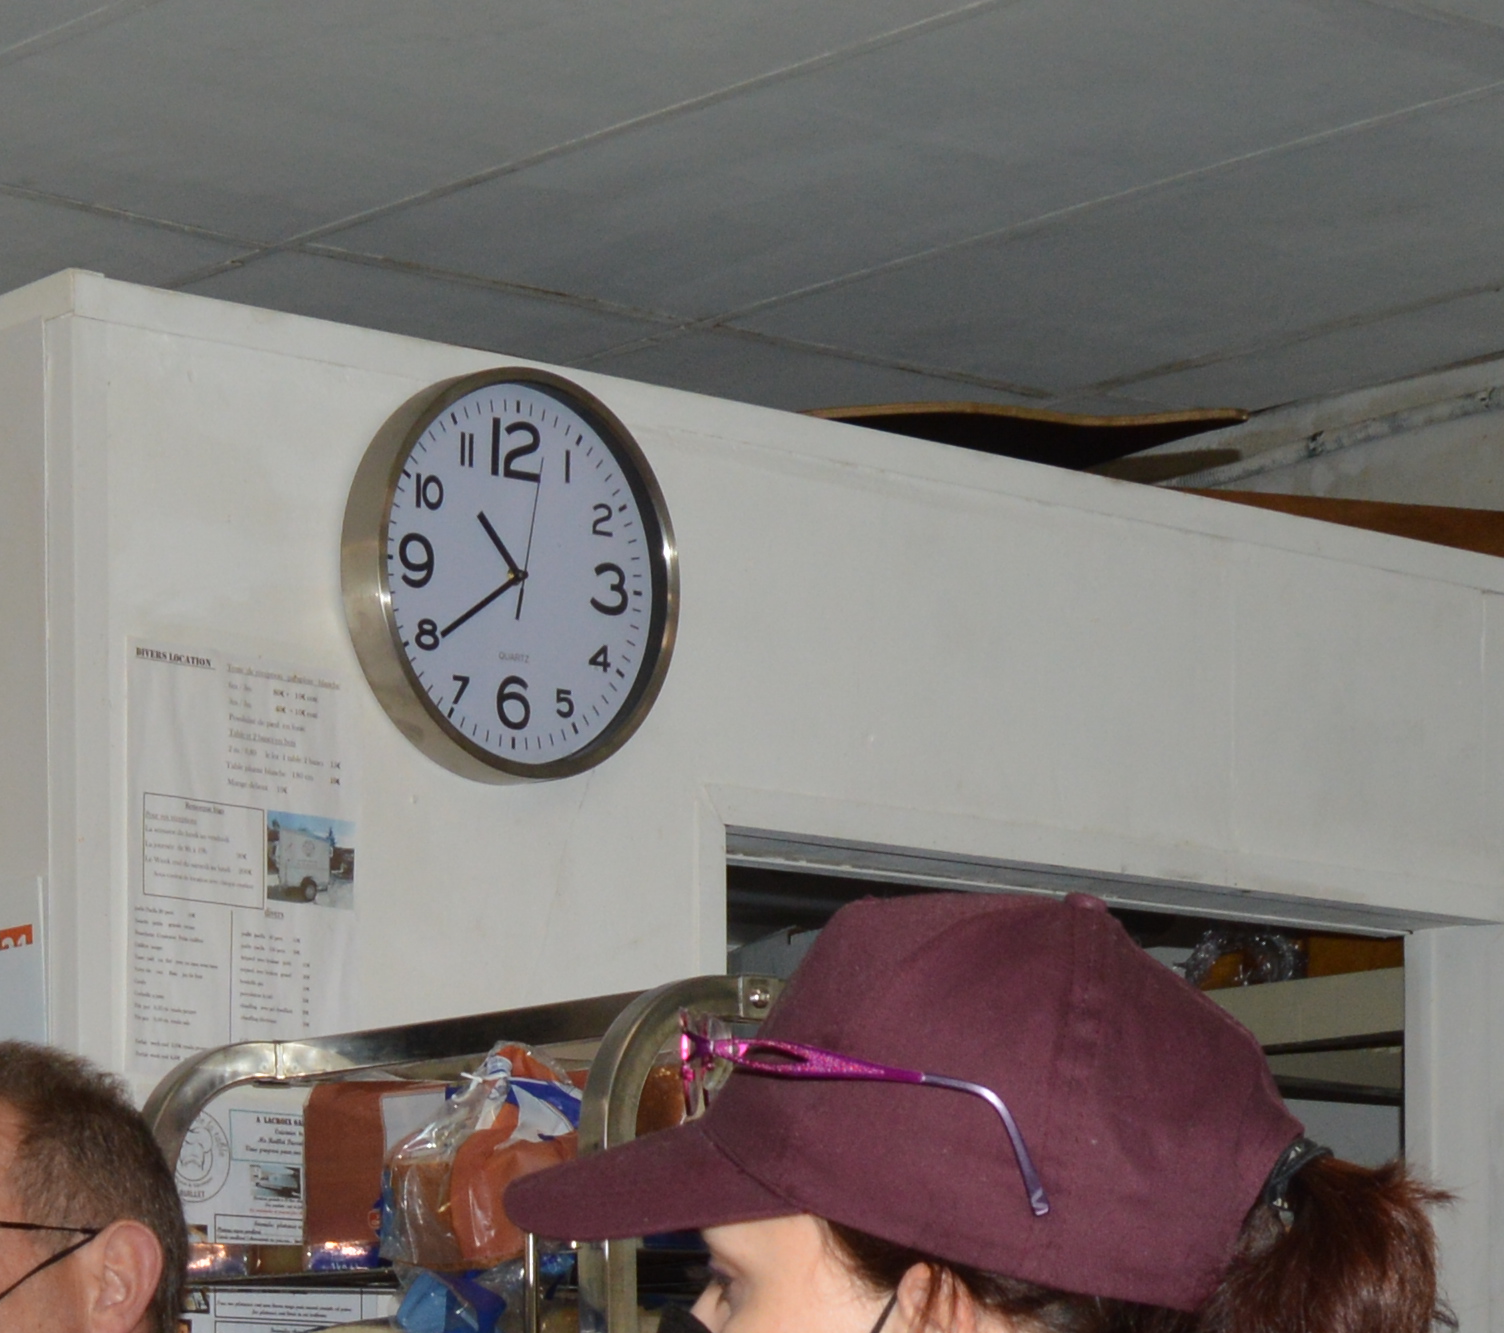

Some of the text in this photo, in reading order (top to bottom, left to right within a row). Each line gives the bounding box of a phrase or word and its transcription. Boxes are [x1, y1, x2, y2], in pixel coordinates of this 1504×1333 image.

[460, 431, 474, 468] 11
[490, 416, 541, 483] 12
[564, 449, 571, 484] 1
[416, 472, 443, 511] 10
[592, 503, 613, 538] 2
[398, 532, 435, 588] 9
[589, 562, 629, 616] 3
[414, 618, 440, 651] 8
[136, 647, 212, 667] DIVERS LOCATION
[498, 651, 531, 664] QUARTZ
[588, 645, 611, 673] 4
[452, 674, 470, 705] 7
[496, 675, 530, 730] 6
[556, 688, 575, 718] 5
